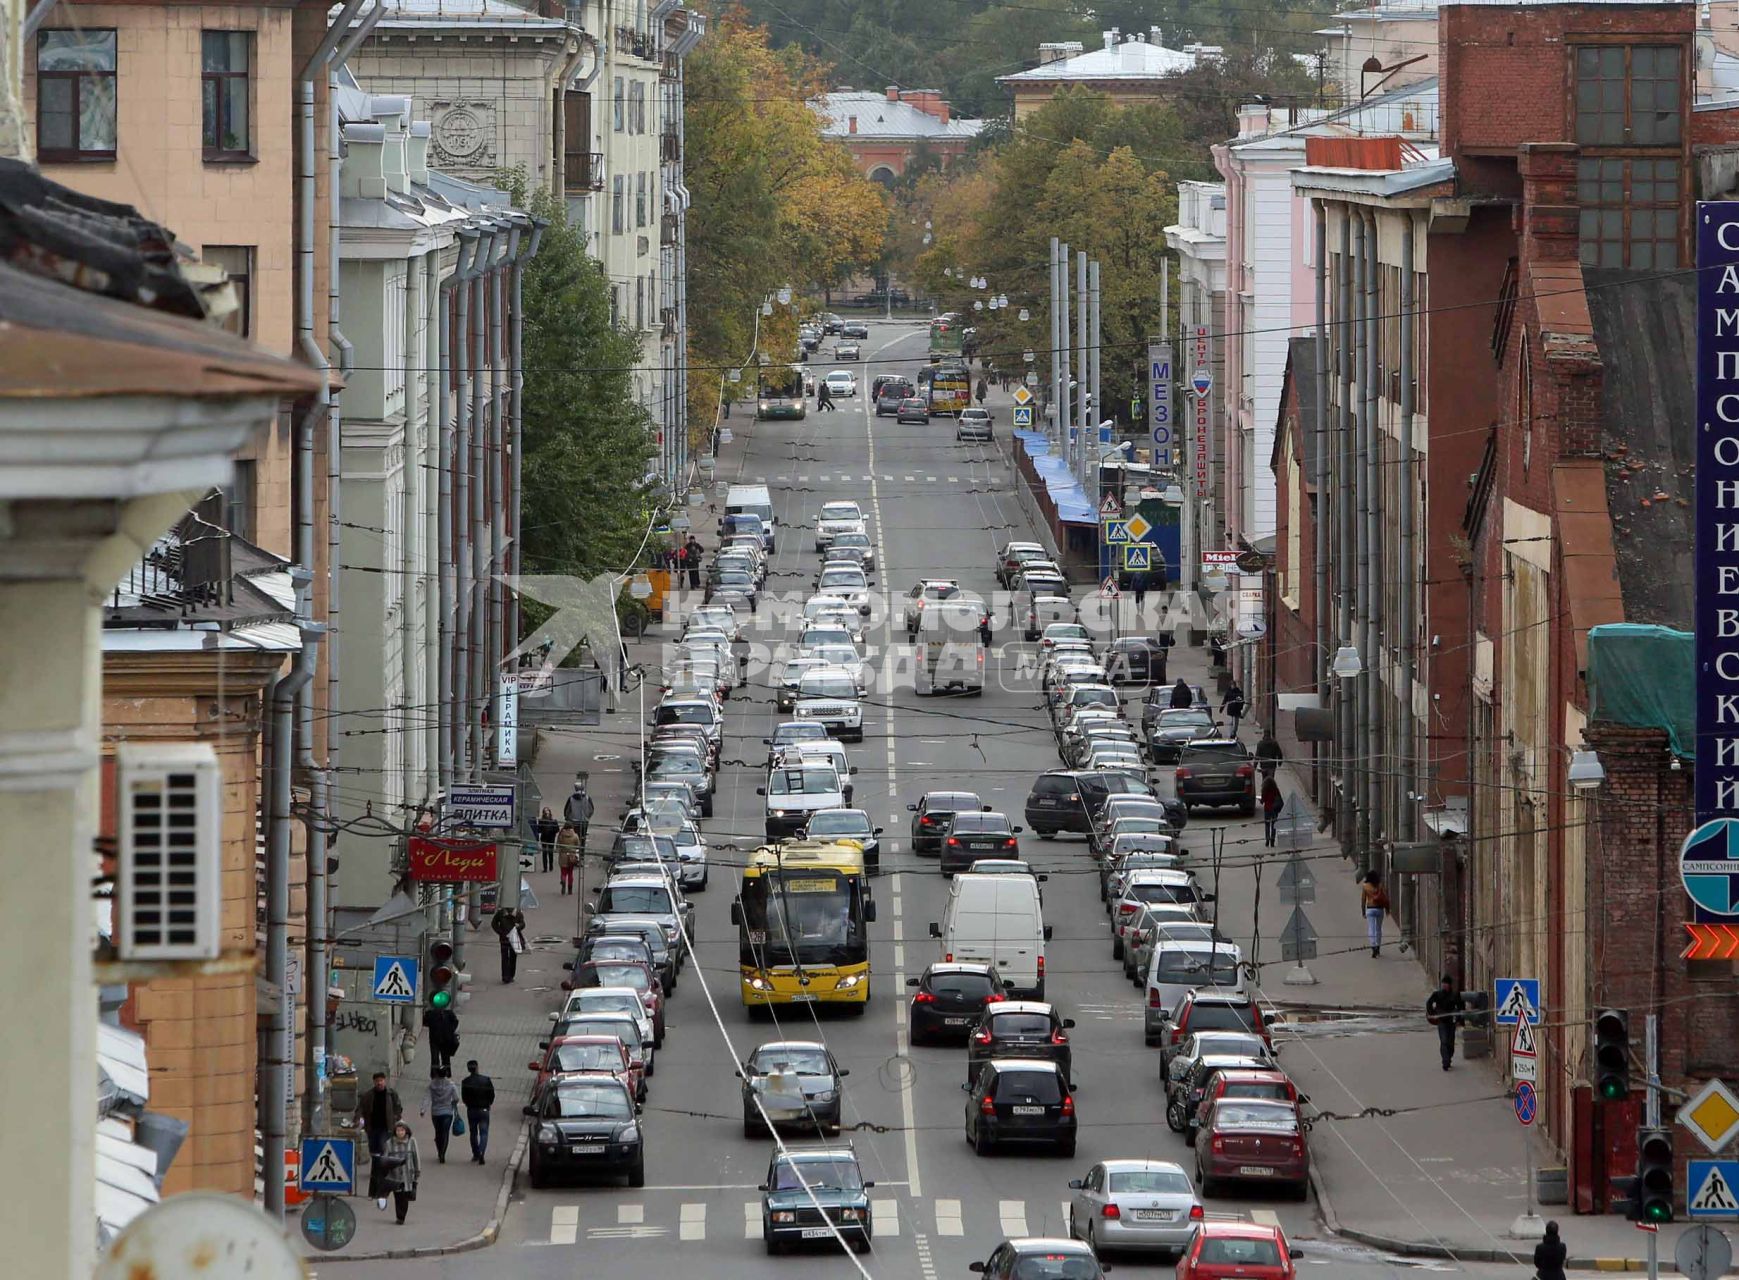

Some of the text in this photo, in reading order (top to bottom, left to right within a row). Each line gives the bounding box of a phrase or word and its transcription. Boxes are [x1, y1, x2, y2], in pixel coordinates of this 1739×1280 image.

[1197, 327, 1206, 366] ЦЕНТР
[1152, 362, 1170, 465] МЕЗОН
[1714, 221, 1739, 811] САМПСОНИЕВСКИЙ
[501, 676, 517, 684] VIP
[504, 686, 512, 755] КЕРАМИКА
[453, 795, 508, 804] КЕРАМИЧЕСКАЯ
[454, 809, 508, 821] ПЛИТКА
